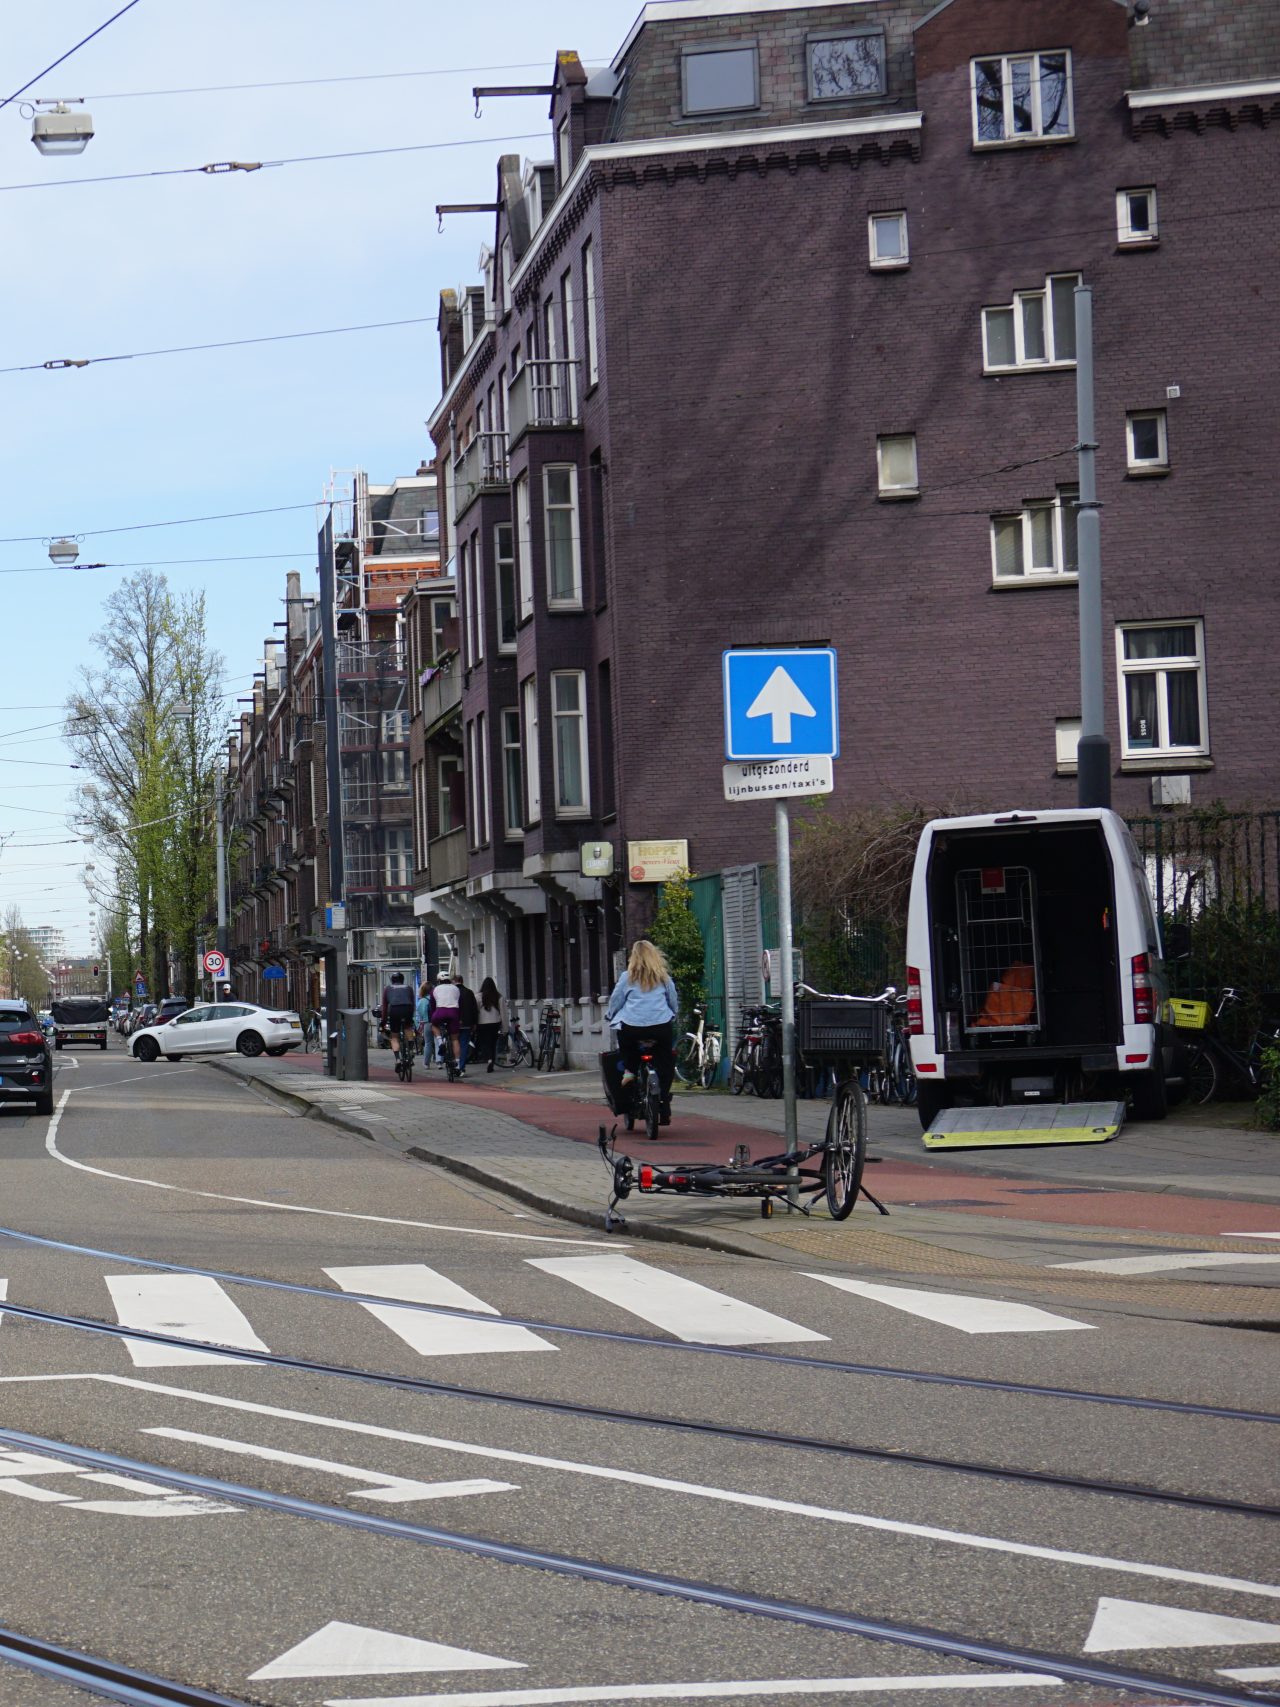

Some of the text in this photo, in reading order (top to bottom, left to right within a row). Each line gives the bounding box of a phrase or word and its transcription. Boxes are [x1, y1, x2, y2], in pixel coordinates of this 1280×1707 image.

[741, 760, 810, 779] uitgezonderd
[728, 778, 826, 795] lijnbussen/taxi's
[638, 846, 678, 856] HOPPE
[208, 957, 221, 966] 30
